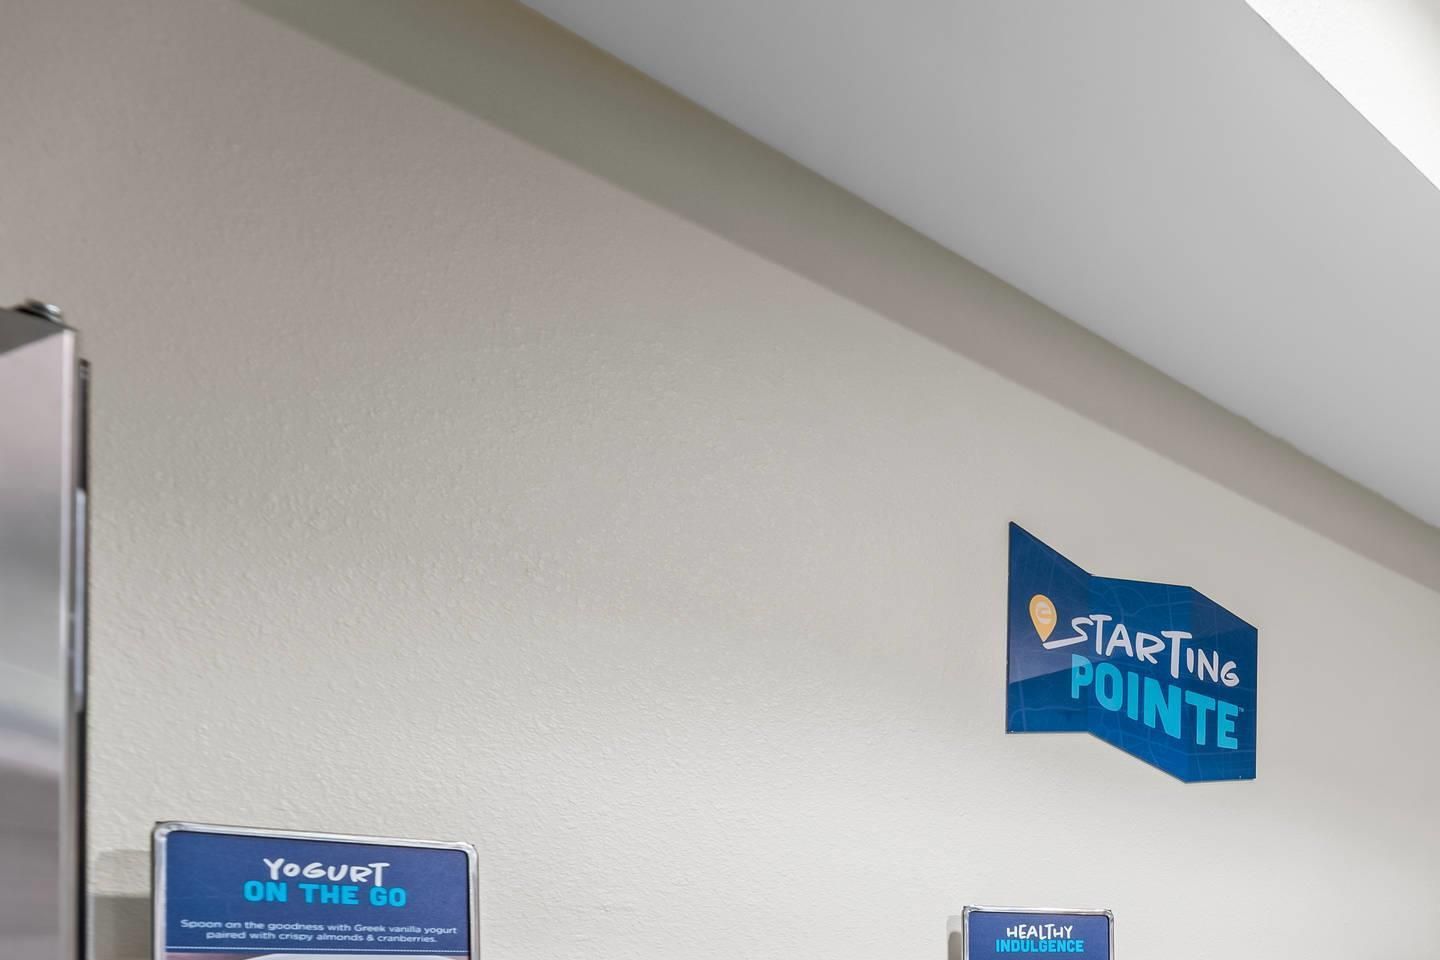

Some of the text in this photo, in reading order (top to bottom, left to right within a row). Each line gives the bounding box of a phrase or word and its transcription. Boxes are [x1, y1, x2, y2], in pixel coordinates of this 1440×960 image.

[1043, 614, 1240, 688] STARTING
[1071, 653, 1240, 750] POINTE
[263, 857, 391, 888] YOGURT
[243, 880, 407, 908] ON THE GO
[180, 919, 458, 935] Spoon on the goodness with Greek vanilla yogurt
[205, 931, 247, 940] paired
[248, 932, 277, 940] with
[278, 932, 313, 942] crispy
[315, 932, 364, 942] almonds
[366, 934, 375, 942] &
[1006, 923, 1073, 940] HEALTHY
[995, 939, 1085, 953] INDULGENCE
